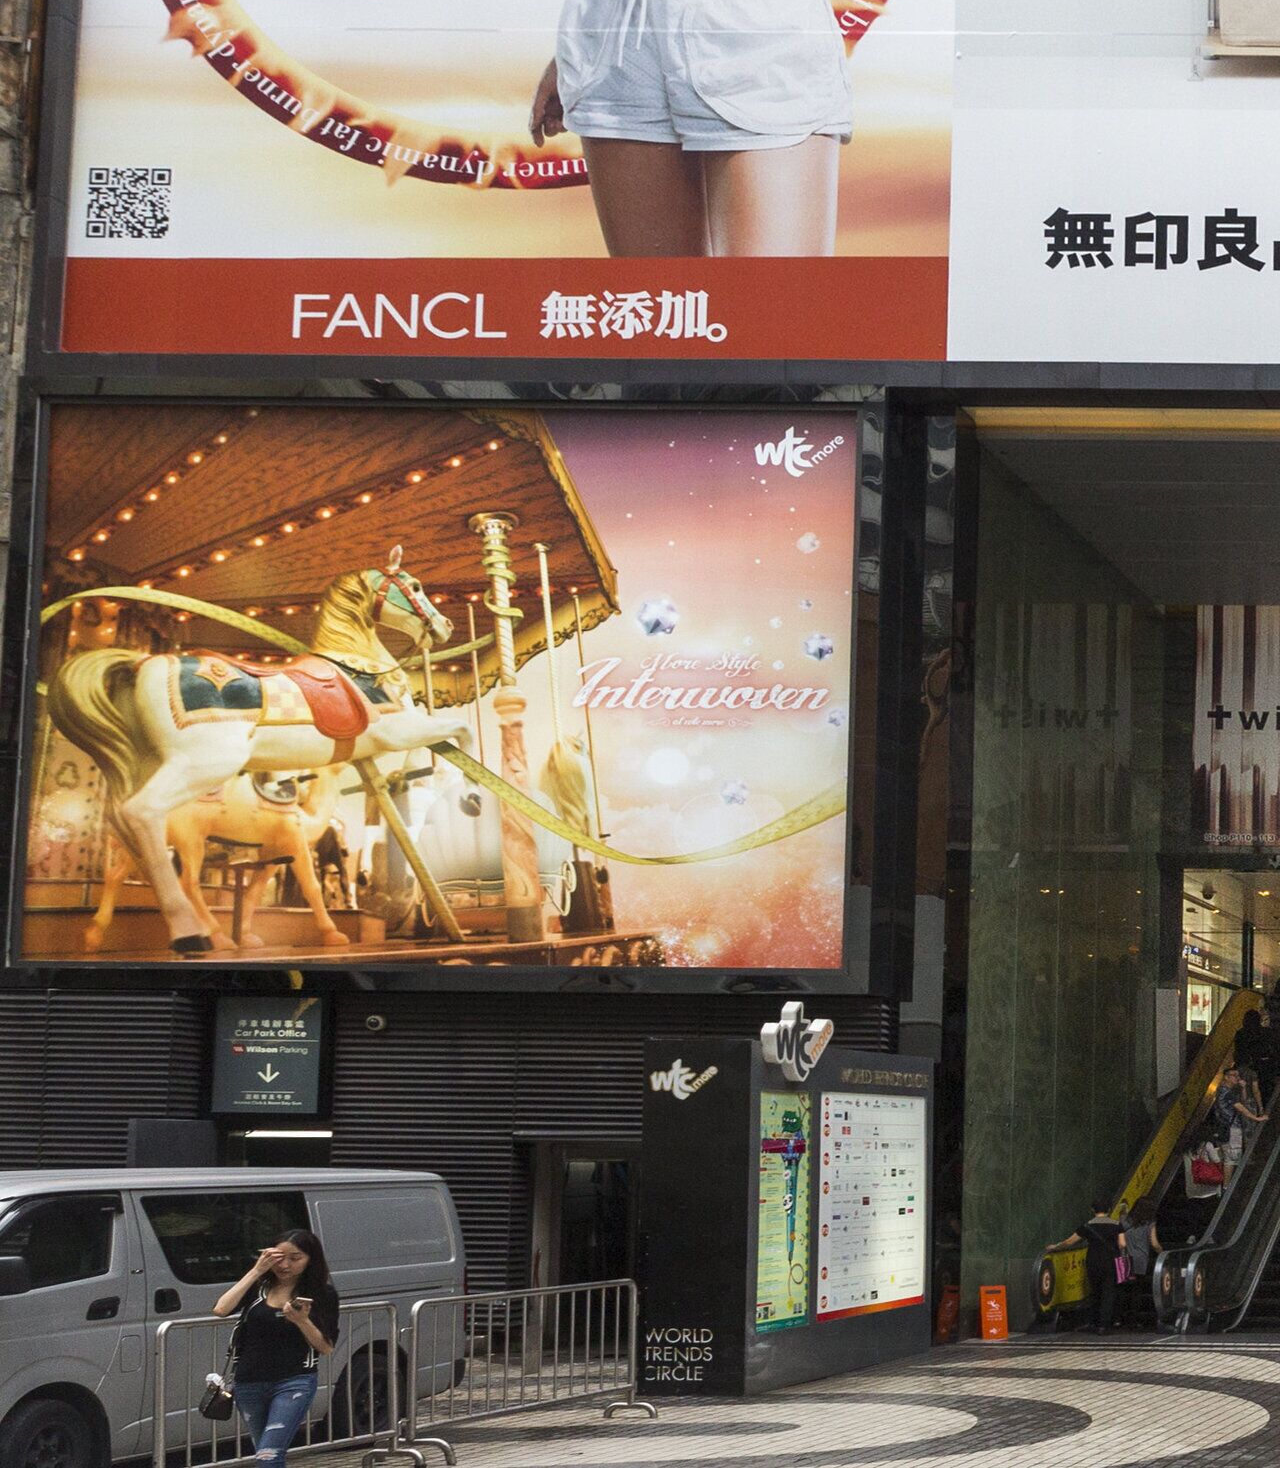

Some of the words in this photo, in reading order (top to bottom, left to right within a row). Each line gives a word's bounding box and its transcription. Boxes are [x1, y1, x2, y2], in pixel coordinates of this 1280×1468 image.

[291, 291, 507, 340] FANCL
[753, 425, 815, 478] wtc
[810, 435, 846, 466] more
[705, 650, 762, 679] Style
[570, 656, 832, 710] Interwoven
[234, 1029, 252, 1037] Car
[254, 1029, 276, 1038] Park
[277, 1029, 308, 1038] Office
[246, 1045, 279, 1054] Wilson
[278, 1045, 309, 1056] Parking
[649, 1058, 697, 1101] wtc
[691, 1065, 720, 1093] more
[645, 1327, 714, 1344] WORLD
[645, 1346, 714, 1362] TRENDS
[644, 1365, 704, 1381] CIRCLE
